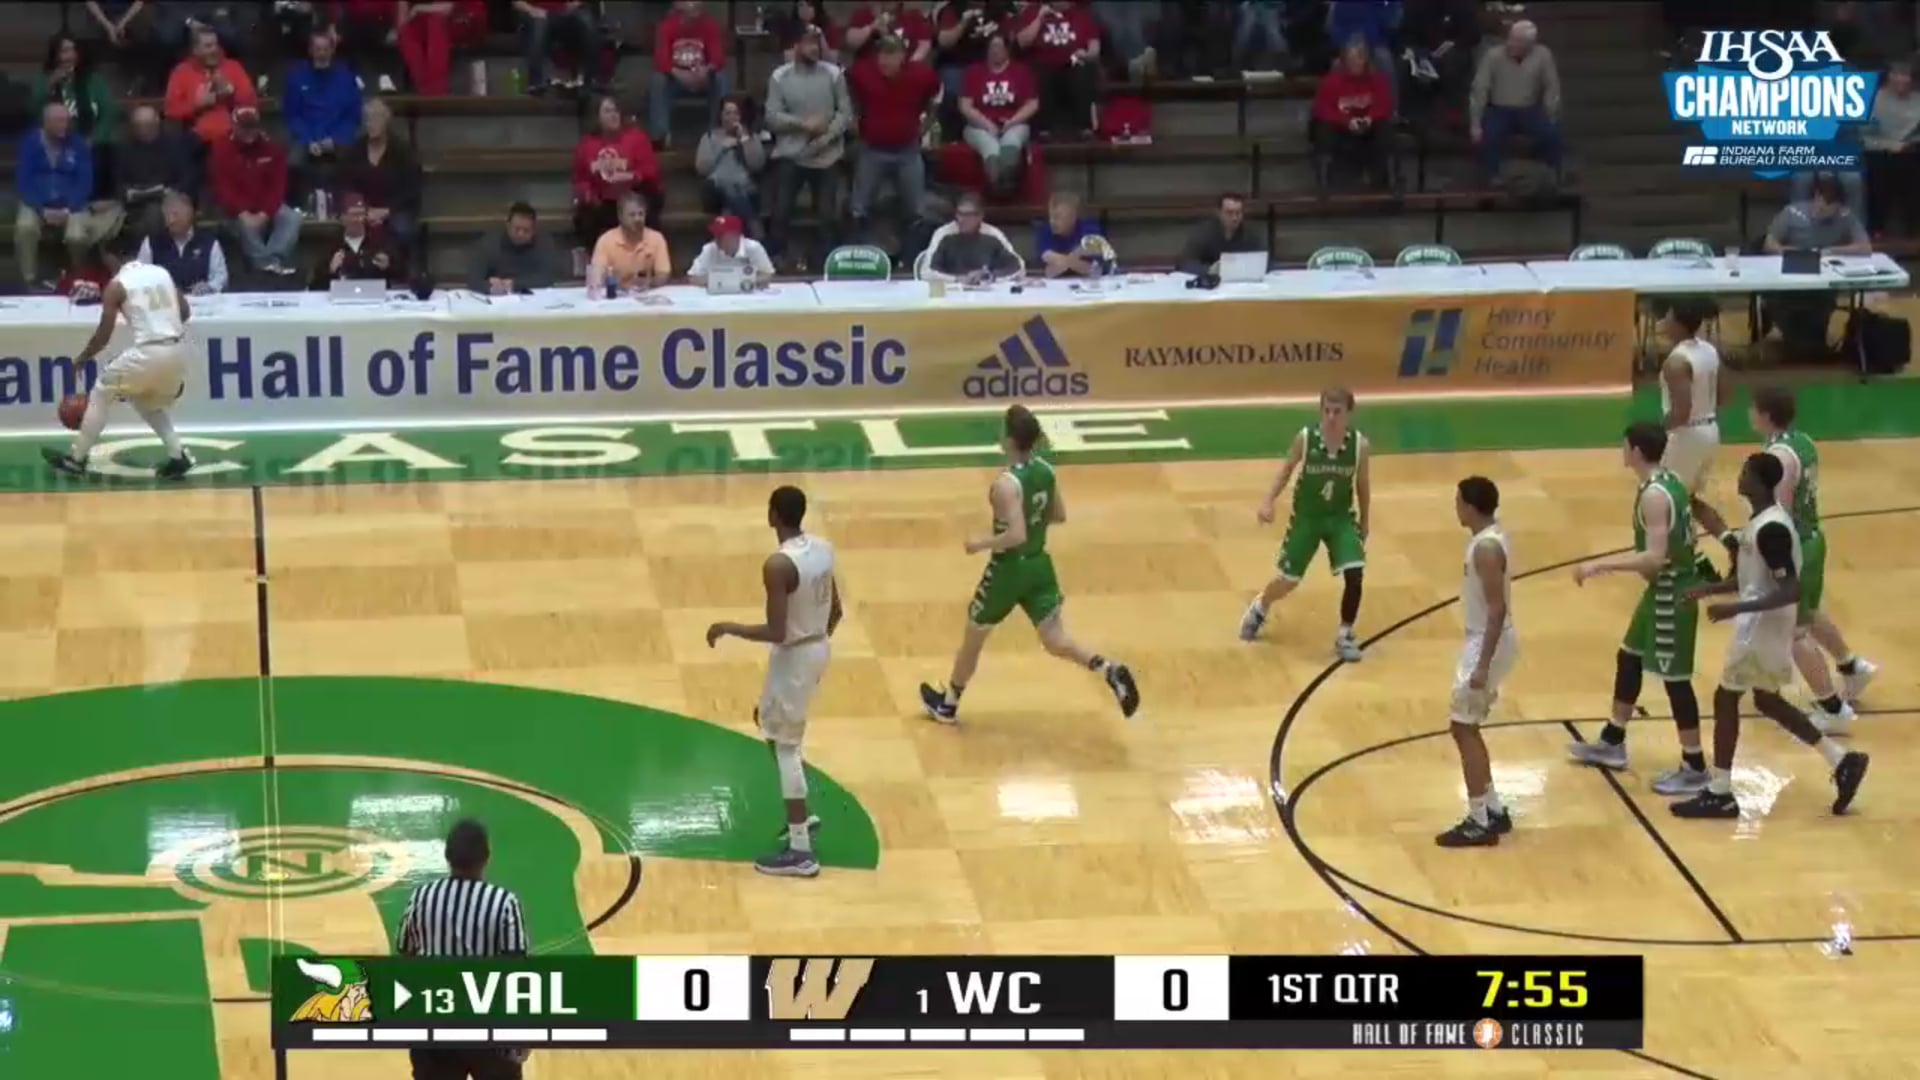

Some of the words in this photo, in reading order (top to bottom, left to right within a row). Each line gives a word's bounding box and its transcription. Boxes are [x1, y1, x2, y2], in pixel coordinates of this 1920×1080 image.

[1487, 306, 1556, 328] Henry
[1481, 329, 1616, 352] Community
[207, 335, 344, 400] Hall
[367, 331, 435, 397] of
[456, 332, 640, 395] Fame
[662, 325, 907, 389] Classic
[1124, 344, 1256, 368] RAYMOND
[1259, 342, 1344, 365] JAMES
[1474, 354, 1551, 375] Health
[963, 367, 1090, 399] adidas
[1320, 480, 1335, 501] 4
[1031, 490, 1048, 525] 2
